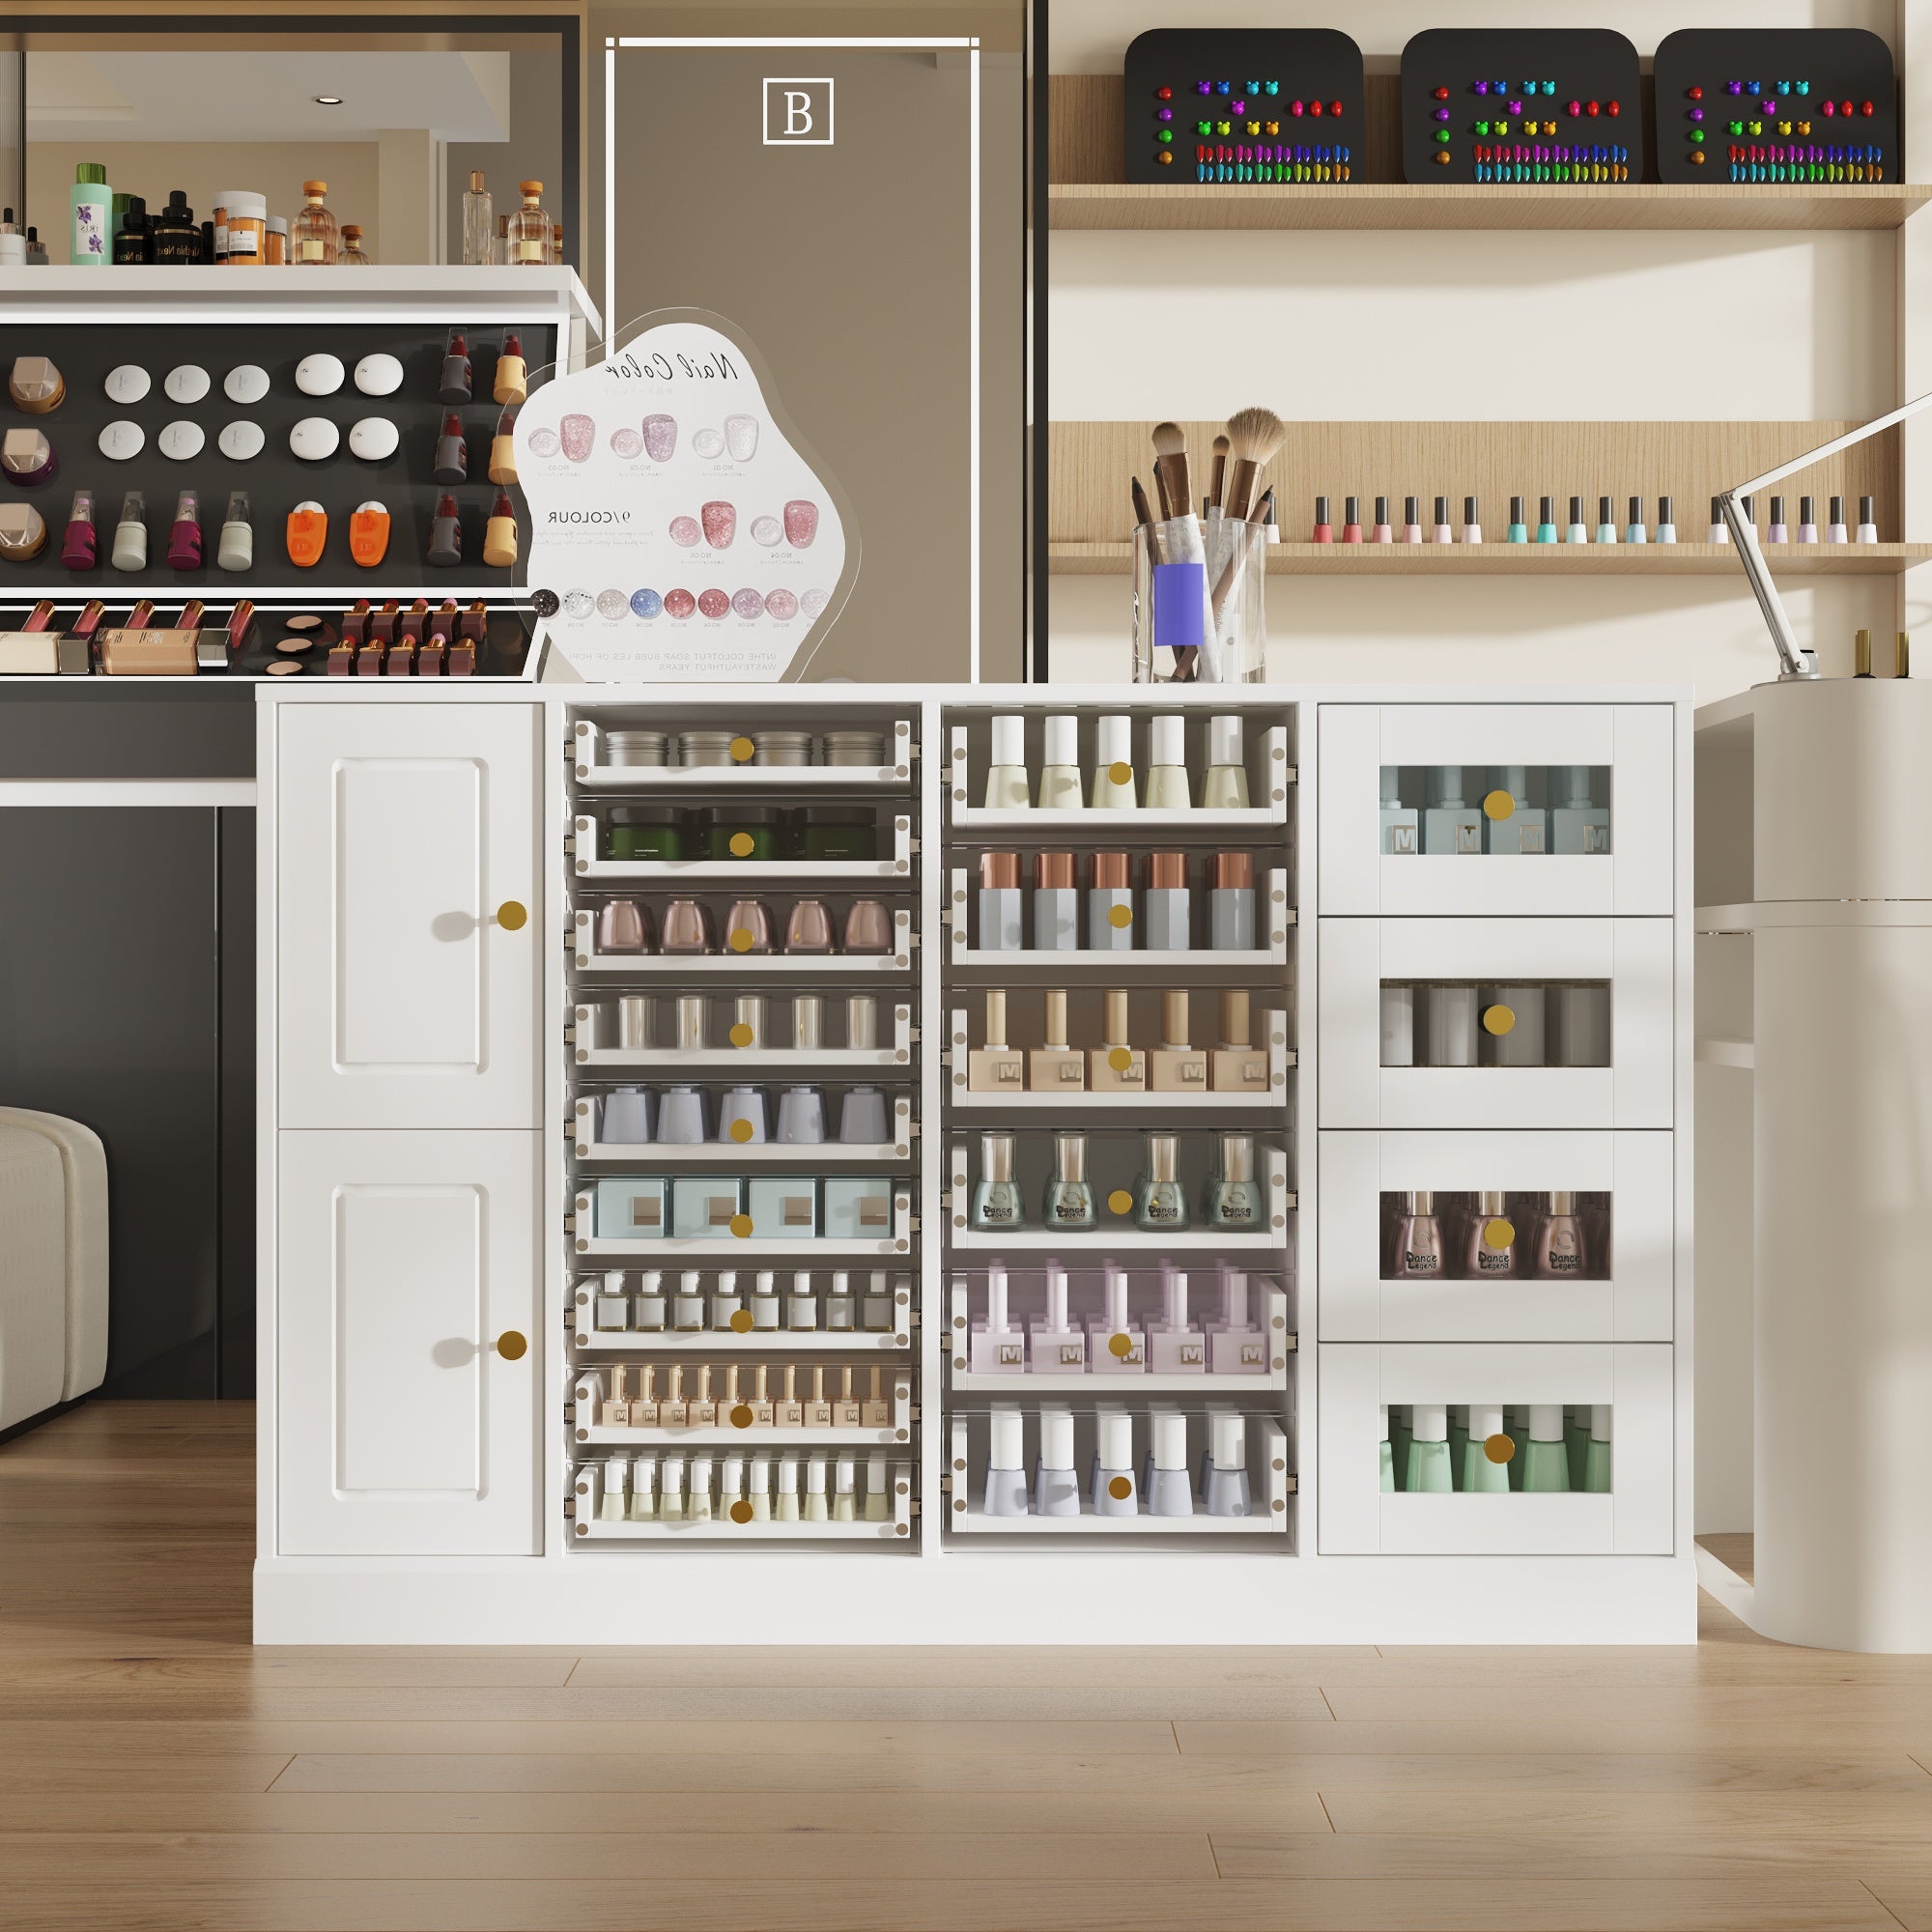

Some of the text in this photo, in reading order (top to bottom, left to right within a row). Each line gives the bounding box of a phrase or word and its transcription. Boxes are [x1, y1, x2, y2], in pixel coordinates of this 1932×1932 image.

[783, 91, 813, 135] B
[1395, 829, 1414, 851] M
[1588, 829, 1607, 851] M
[1000, 1064, 1020, 1079] M
[1062, 1064, 1081, 1079] M
[1122, 1064, 1142, 1079] M
[1183, 1064, 1204, 1079] M
[1245, 1064, 1265, 1079] M
[983, 1205, 1013, 1215] Dance
[984, 1210, 1012, 1220] Legend
[1056, 1205, 1086, 1215] Dance
[1057, 1210, 1085, 1220] Legend
[1148, 1205, 1178, 1215] Dance
[1149, 1210, 1177, 1220] Legend
[1221, 1205, 1251, 1215] Dance
[1222, 1210, 1250, 1220] Legend
[1406, 1251, 1437, 1263] Dance
[1478, 1251, 1509, 1263] Dance
[1549, 1251, 1580, 1263] Dance
[1407, 1259, 1436, 1270] Legend
[1479, 1259, 1508, 1270] Legend
[1550, 1259, 1579, 1270] Legend
[1002, 1346, 1022, 1361] M
[1062, 1346, 1082, 1361] M
[1122, 1346, 1143, 1361] M
[1182, 1346, 1203, 1361] M
[1243, 1346, 1264, 1361] M
